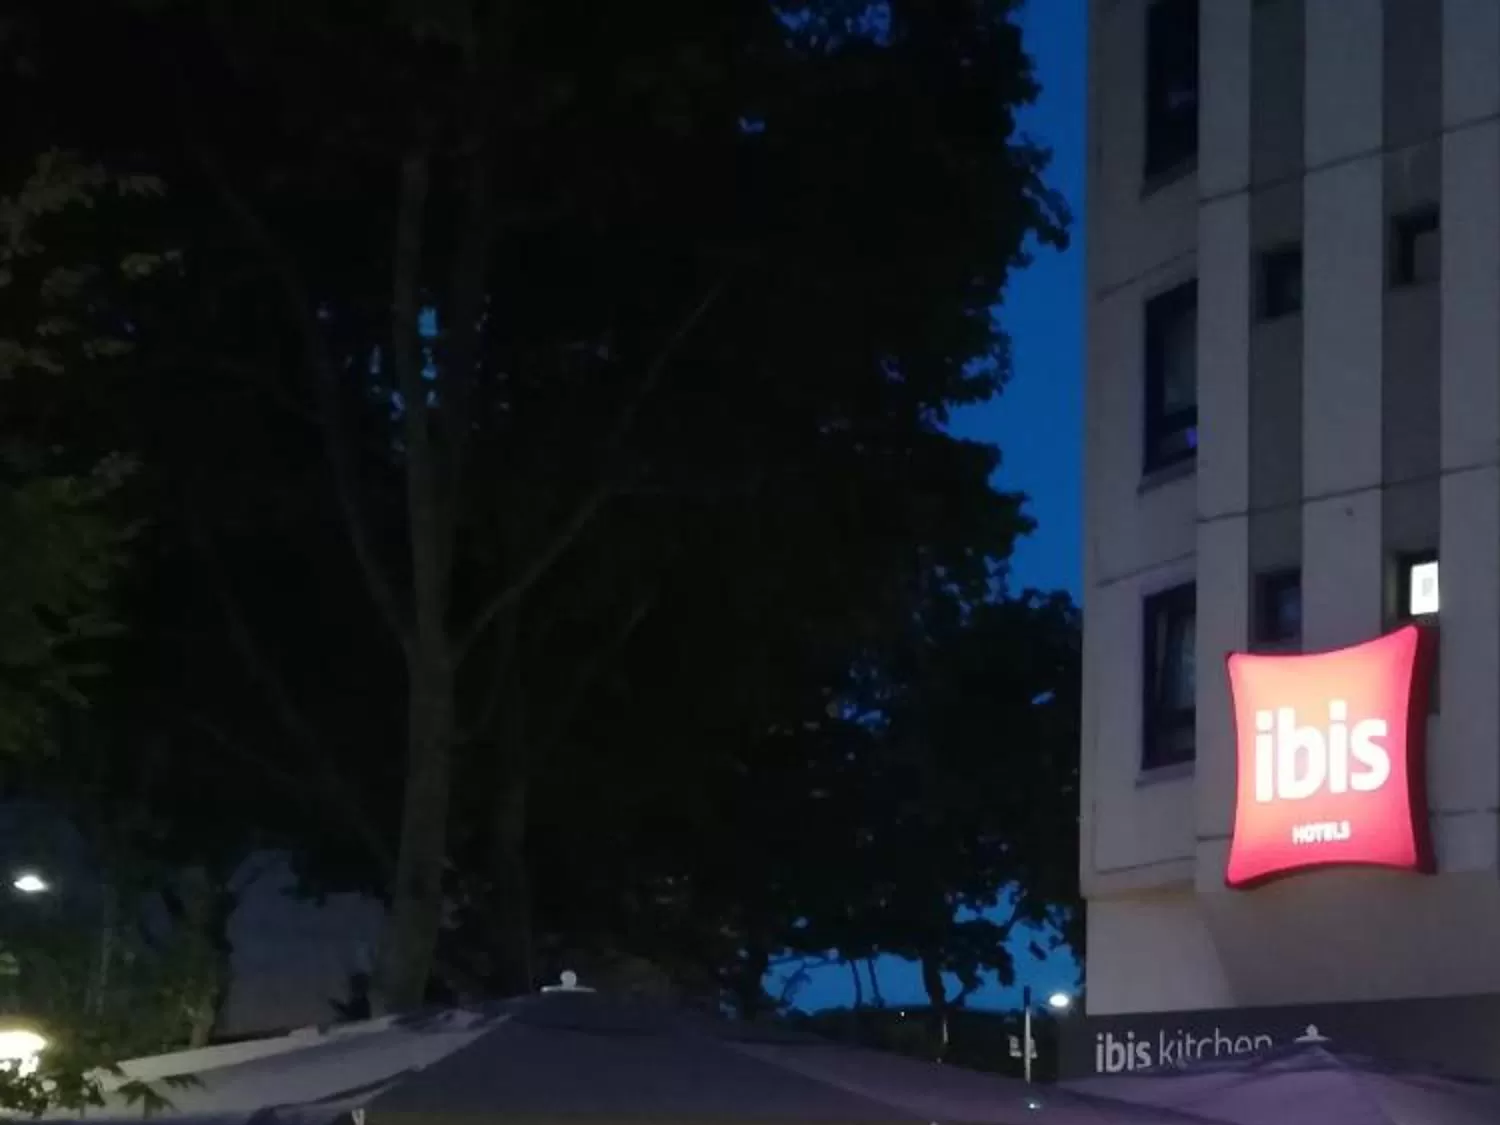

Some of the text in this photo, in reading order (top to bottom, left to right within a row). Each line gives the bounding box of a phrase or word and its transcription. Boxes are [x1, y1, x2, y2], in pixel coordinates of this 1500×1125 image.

[1254, 698, 1391, 802] ibis
[1292, 820, 1351, 845] HOTELS
[1095, 1031, 1152, 1073] ibis
